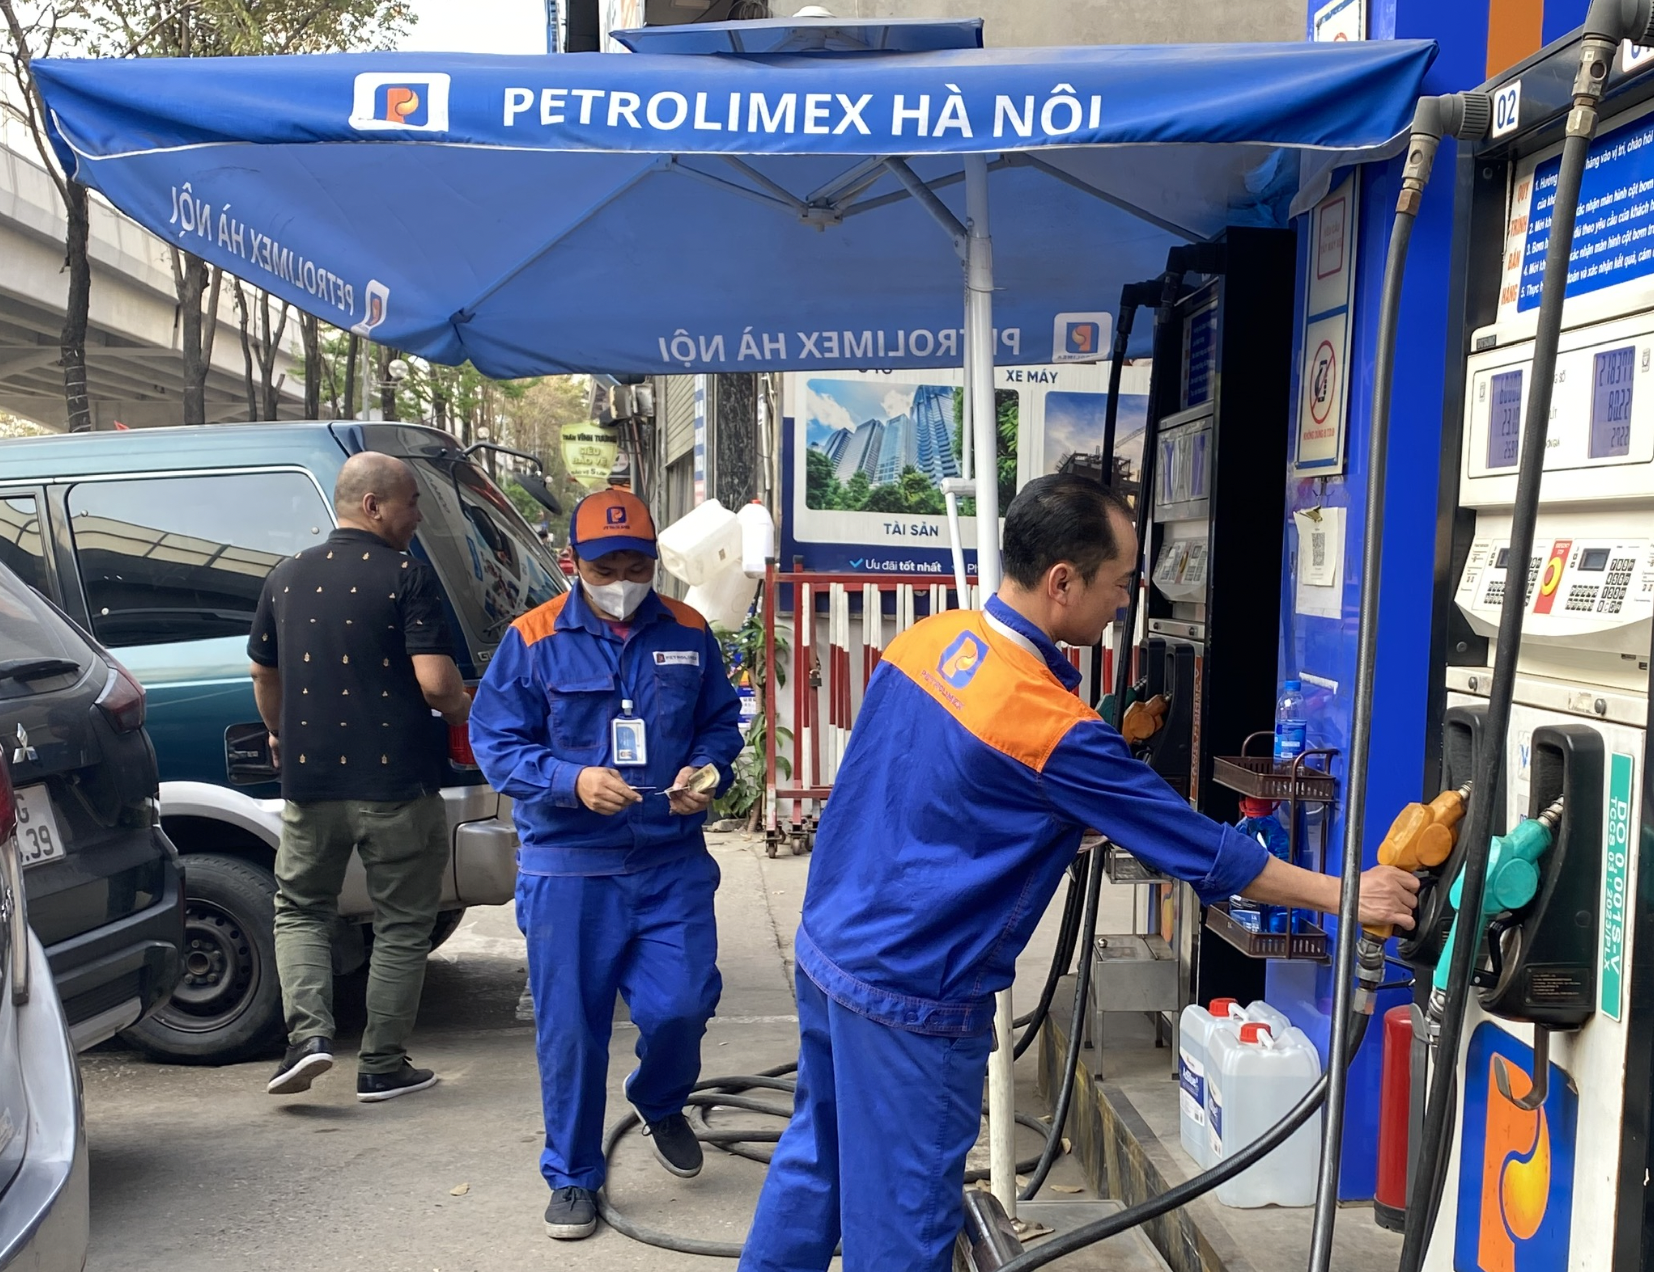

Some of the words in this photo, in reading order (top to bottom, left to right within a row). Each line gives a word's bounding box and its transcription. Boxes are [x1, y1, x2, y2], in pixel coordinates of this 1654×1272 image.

[503, 87, 874, 135] PETROLIMEX
[891, 83, 974, 138] HÀ
[1497, 89, 1517, 130] 02
[1601, 152, 1611, 164] vào
[1627, 137, 1642, 152] chào
[1630, 203, 1649, 221] khách
[1006, 369, 1023, 383] XE
[1027, 368, 1058, 384] MÁY
[883, 520, 906, 536] TÀI
[910, 521, 939, 537] SẢN
[865, 558, 881, 570] Ưu
[881, 559, 898, 571] đãi
[899, 560, 916, 572] tốt
[916, 561, 942, 573] nhất
[1609, 795, 1617, 846] TCCS
[1616, 801, 1627, 844] DO
[1608, 851, 1615, 872] 03
[1603, 888, 1614, 972] 2023/PLX
